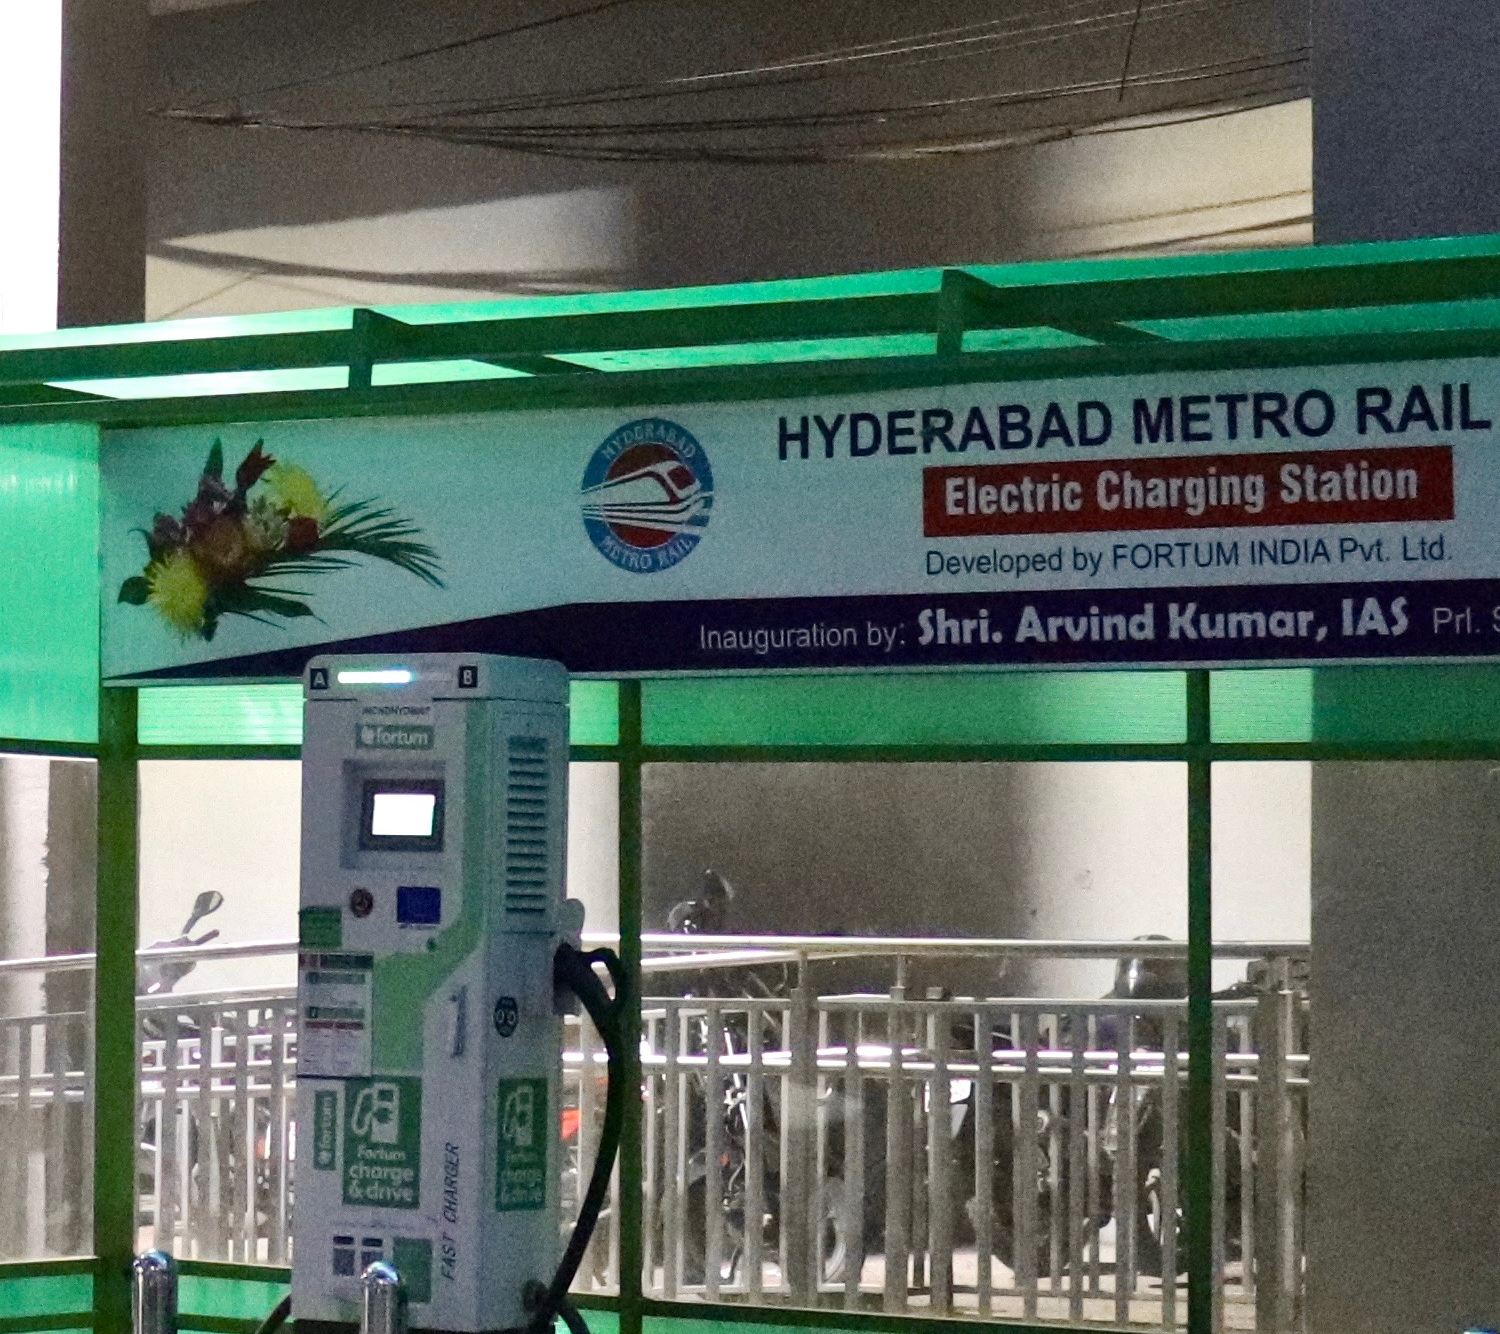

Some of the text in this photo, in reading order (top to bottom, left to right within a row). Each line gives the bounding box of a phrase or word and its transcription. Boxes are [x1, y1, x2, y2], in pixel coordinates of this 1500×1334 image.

[778, 401, 1112, 461] HYDERABAD
[1132, 388, 1336, 445] METRO
[1356, 382, 1492, 435] RAIL
[601, 423, 697, 461] HYDERABAD
[945, 459, 1419, 517] Electric Charging Station
[600, 534, 694, 570] METRO RAIL
[927, 534, 1454, 579] Developed by FORTUM INDIA Pvt. Ltd.
[701, 622, 857, 655] Inauguration
[866, 621, 906, 652] by:
[918, 608, 1003, 647] Shri.
[1016, 604, 1157, 645] Arvind
[1168, 604, 1328, 645] Kumar,
[1342, 596, 1410, 638] IAS
[312, 671, 326, 686] A
[462, 669, 473, 684] B
[376, 727, 429, 745] fortum
[349, 1161, 414, 1186] charge
[349, 1179, 414, 1201] & drive
[441, 1142, 459, 1282] FAST CHARGER
